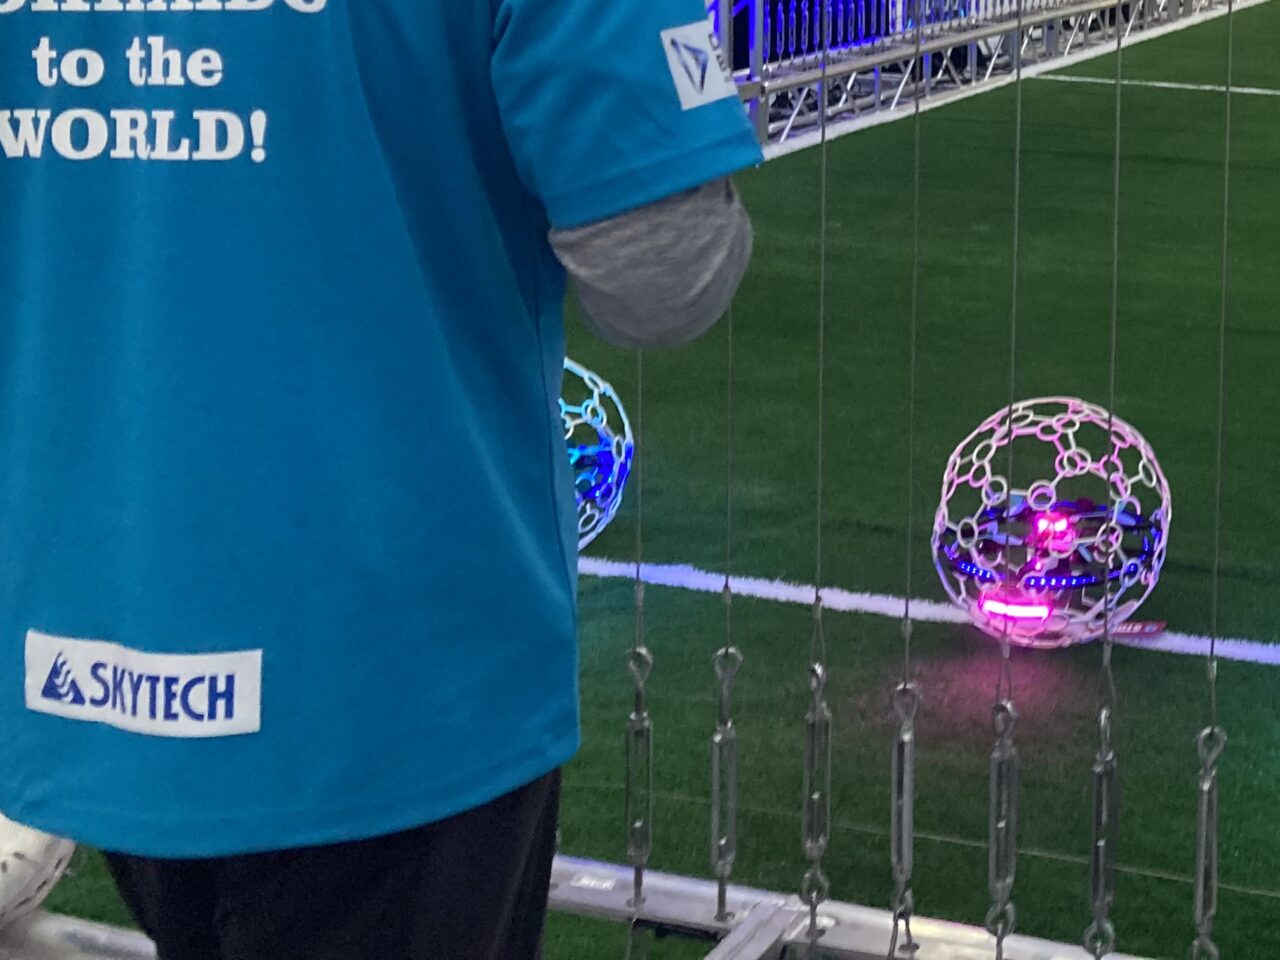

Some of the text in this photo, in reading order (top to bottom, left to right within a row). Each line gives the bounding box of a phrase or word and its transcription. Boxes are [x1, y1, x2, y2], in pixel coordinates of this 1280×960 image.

[32, 35, 223, 87] to the
[0, 108, 267, 164] WORLD!
[89, 661, 235, 723] SKYTECH
